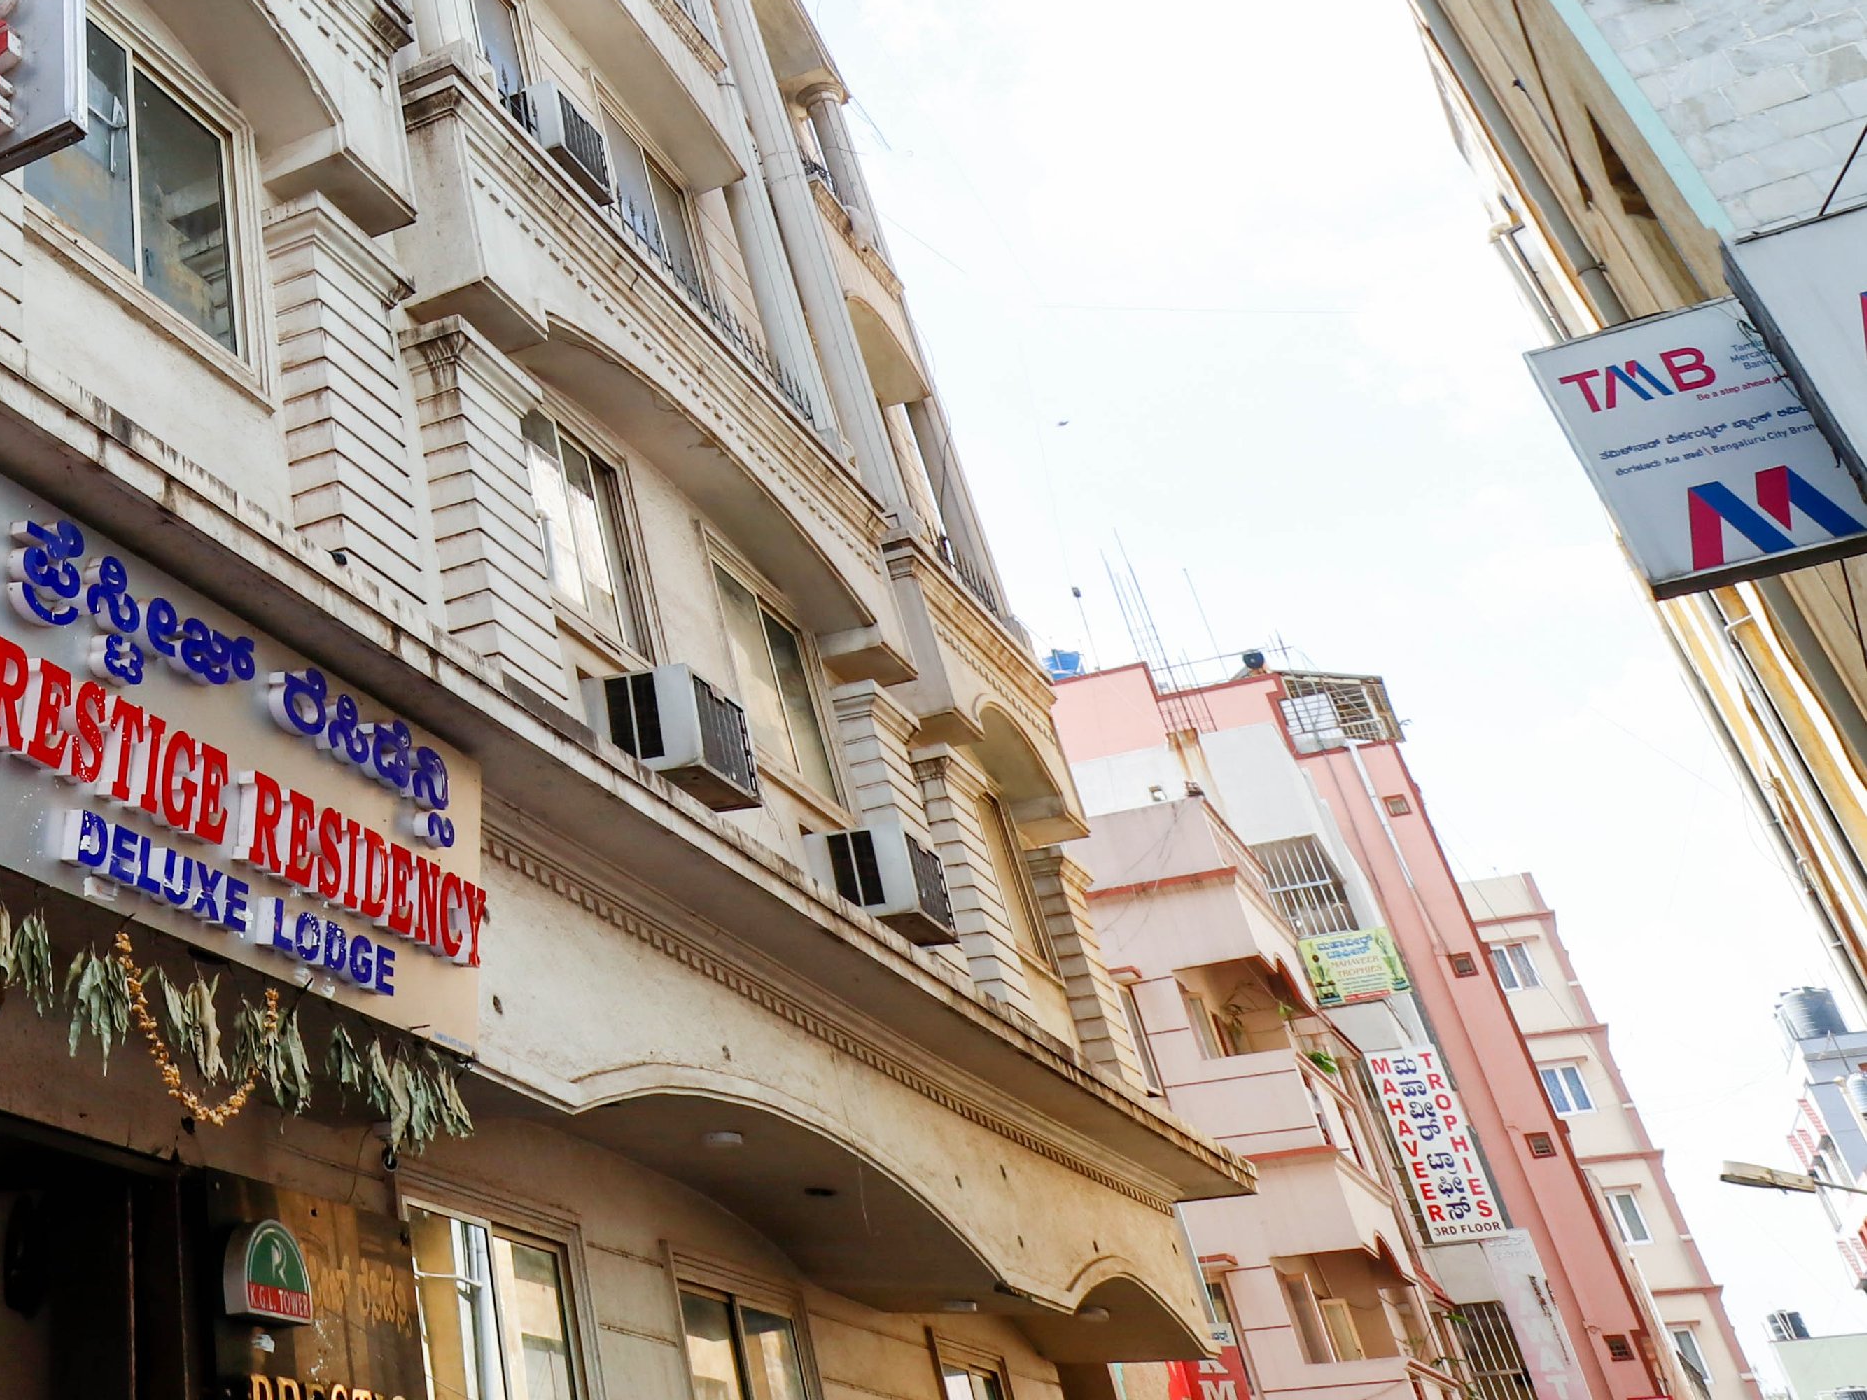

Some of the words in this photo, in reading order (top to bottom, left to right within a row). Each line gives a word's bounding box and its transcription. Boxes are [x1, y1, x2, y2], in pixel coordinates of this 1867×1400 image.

[1558, 347, 1716, 413] TMB
[1711, 435, 1766, 453] Bengaluru
[1766, 430, 1787, 440] City
[1788, 423, 1816, 435] Bran
[69, 808, 250, 933] DELUXE
[262, 895, 397, 997] LODGE
[238, 769, 488, 966] RESIDENCY
[1370, 1057, 1446, 1223] MAHAVEER
[1418, 1053, 1494, 1218] TROPHIES
[1433, 1225, 1457, 1237] 3RD
[1461, 1221, 1502, 1234] FLOOR
[278, 1288, 310, 1317] TOWER
